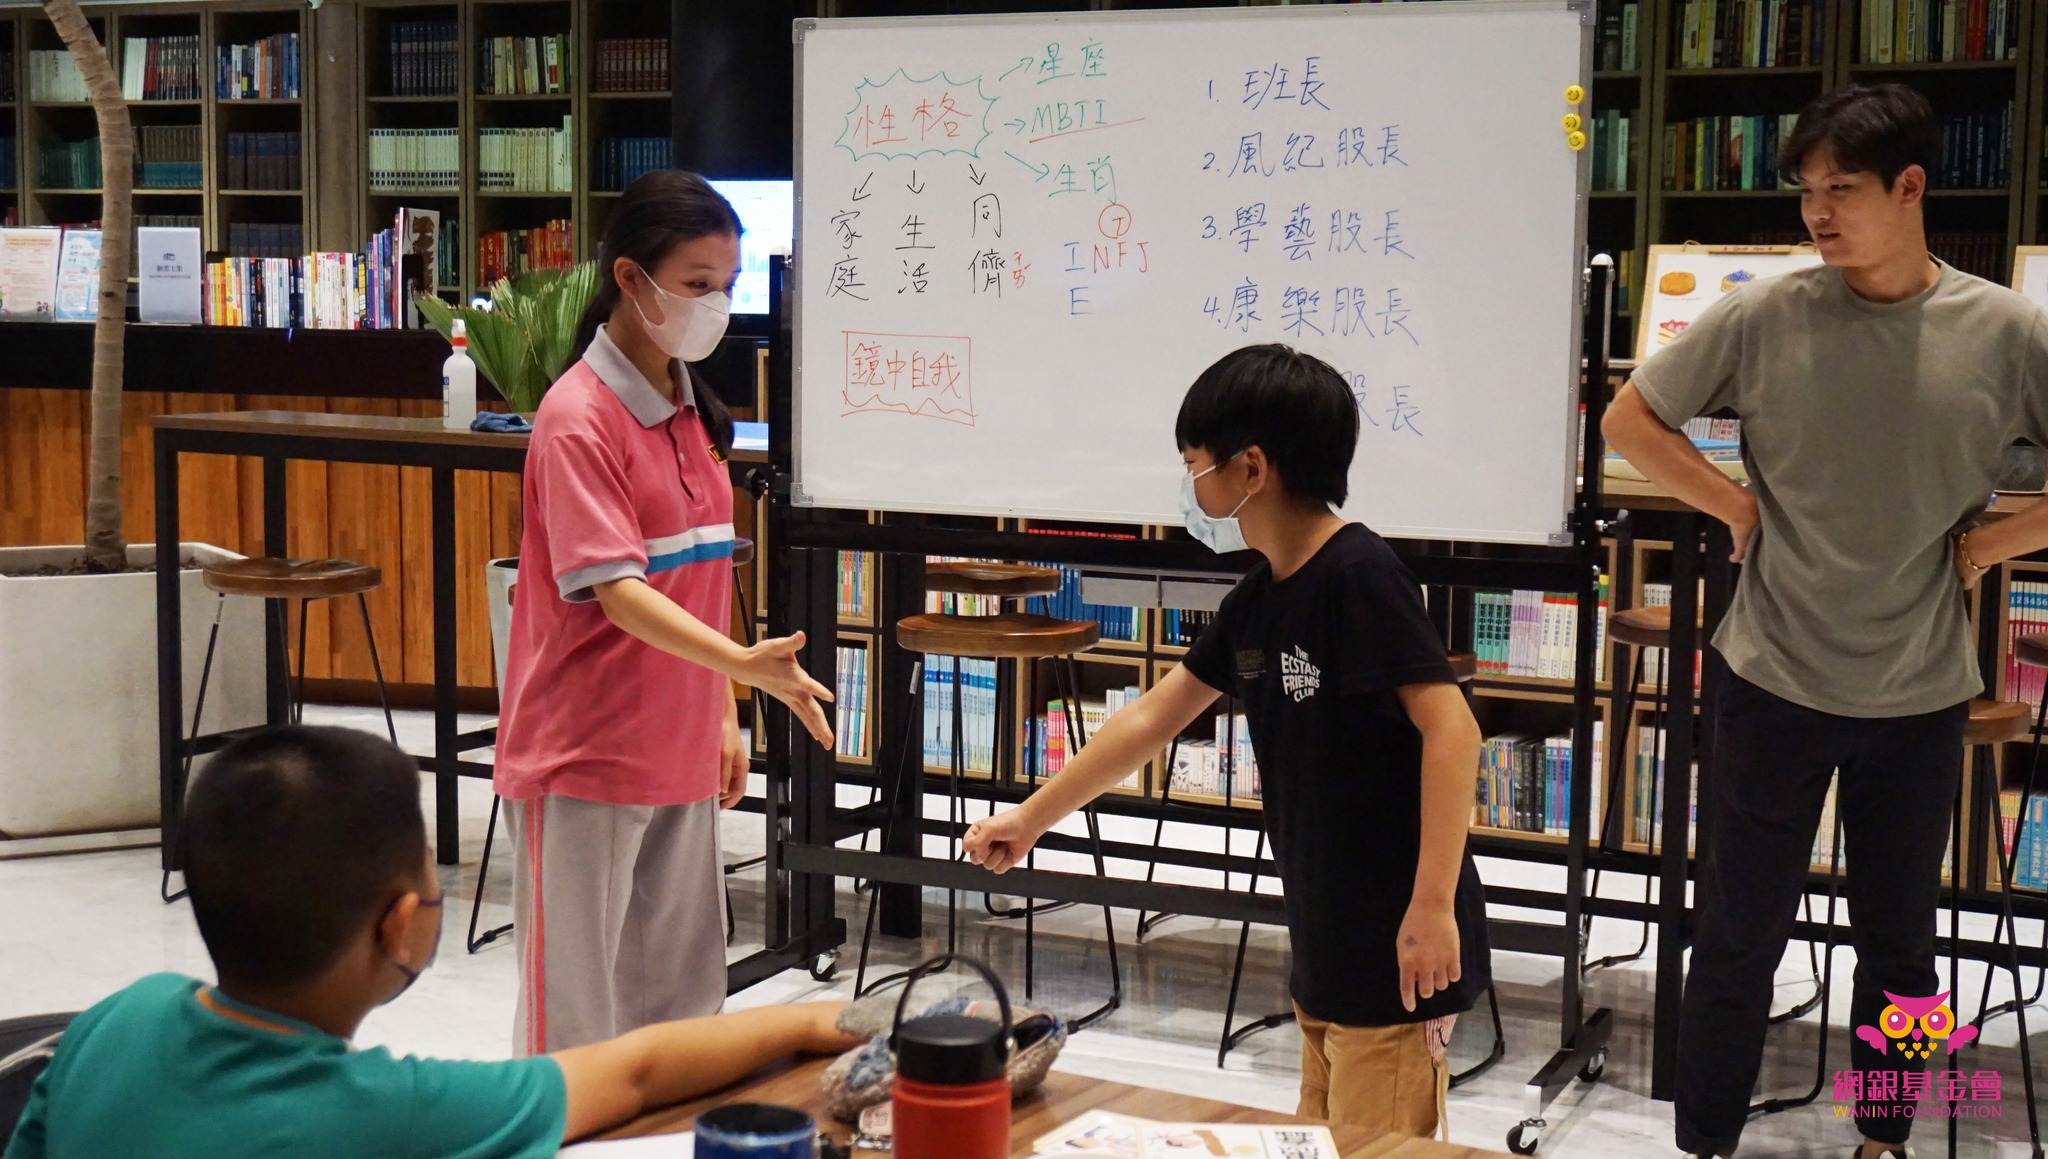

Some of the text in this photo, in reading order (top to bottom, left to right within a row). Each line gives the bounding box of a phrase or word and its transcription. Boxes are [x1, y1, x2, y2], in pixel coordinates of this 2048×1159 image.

[1036, 37, 1108, 84] 星座
[1243, 56, 1330, 111] 班長
[853, 92, 973, 149] 性格
[1031, 99, 1108, 135] MBTI
[1048, 155, 1118, 205] 生肖
[825, 209, 869, 301] 家庭
[895, 213, 936, 295] 生活
[968, 193, 1006, 299] 同儕
[1063, 240, 1150, 274] INFJ
[1069, 286, 1093, 316] E
[850, 340, 962, 400] 鏡中自我
[1281, 651, 1321, 678] ECSTASY
[1294, 644, 1309, 662] THE
[1282, 674, 1320, 695] FRIENDS
[1293, 687, 1315, 703] CLUB
